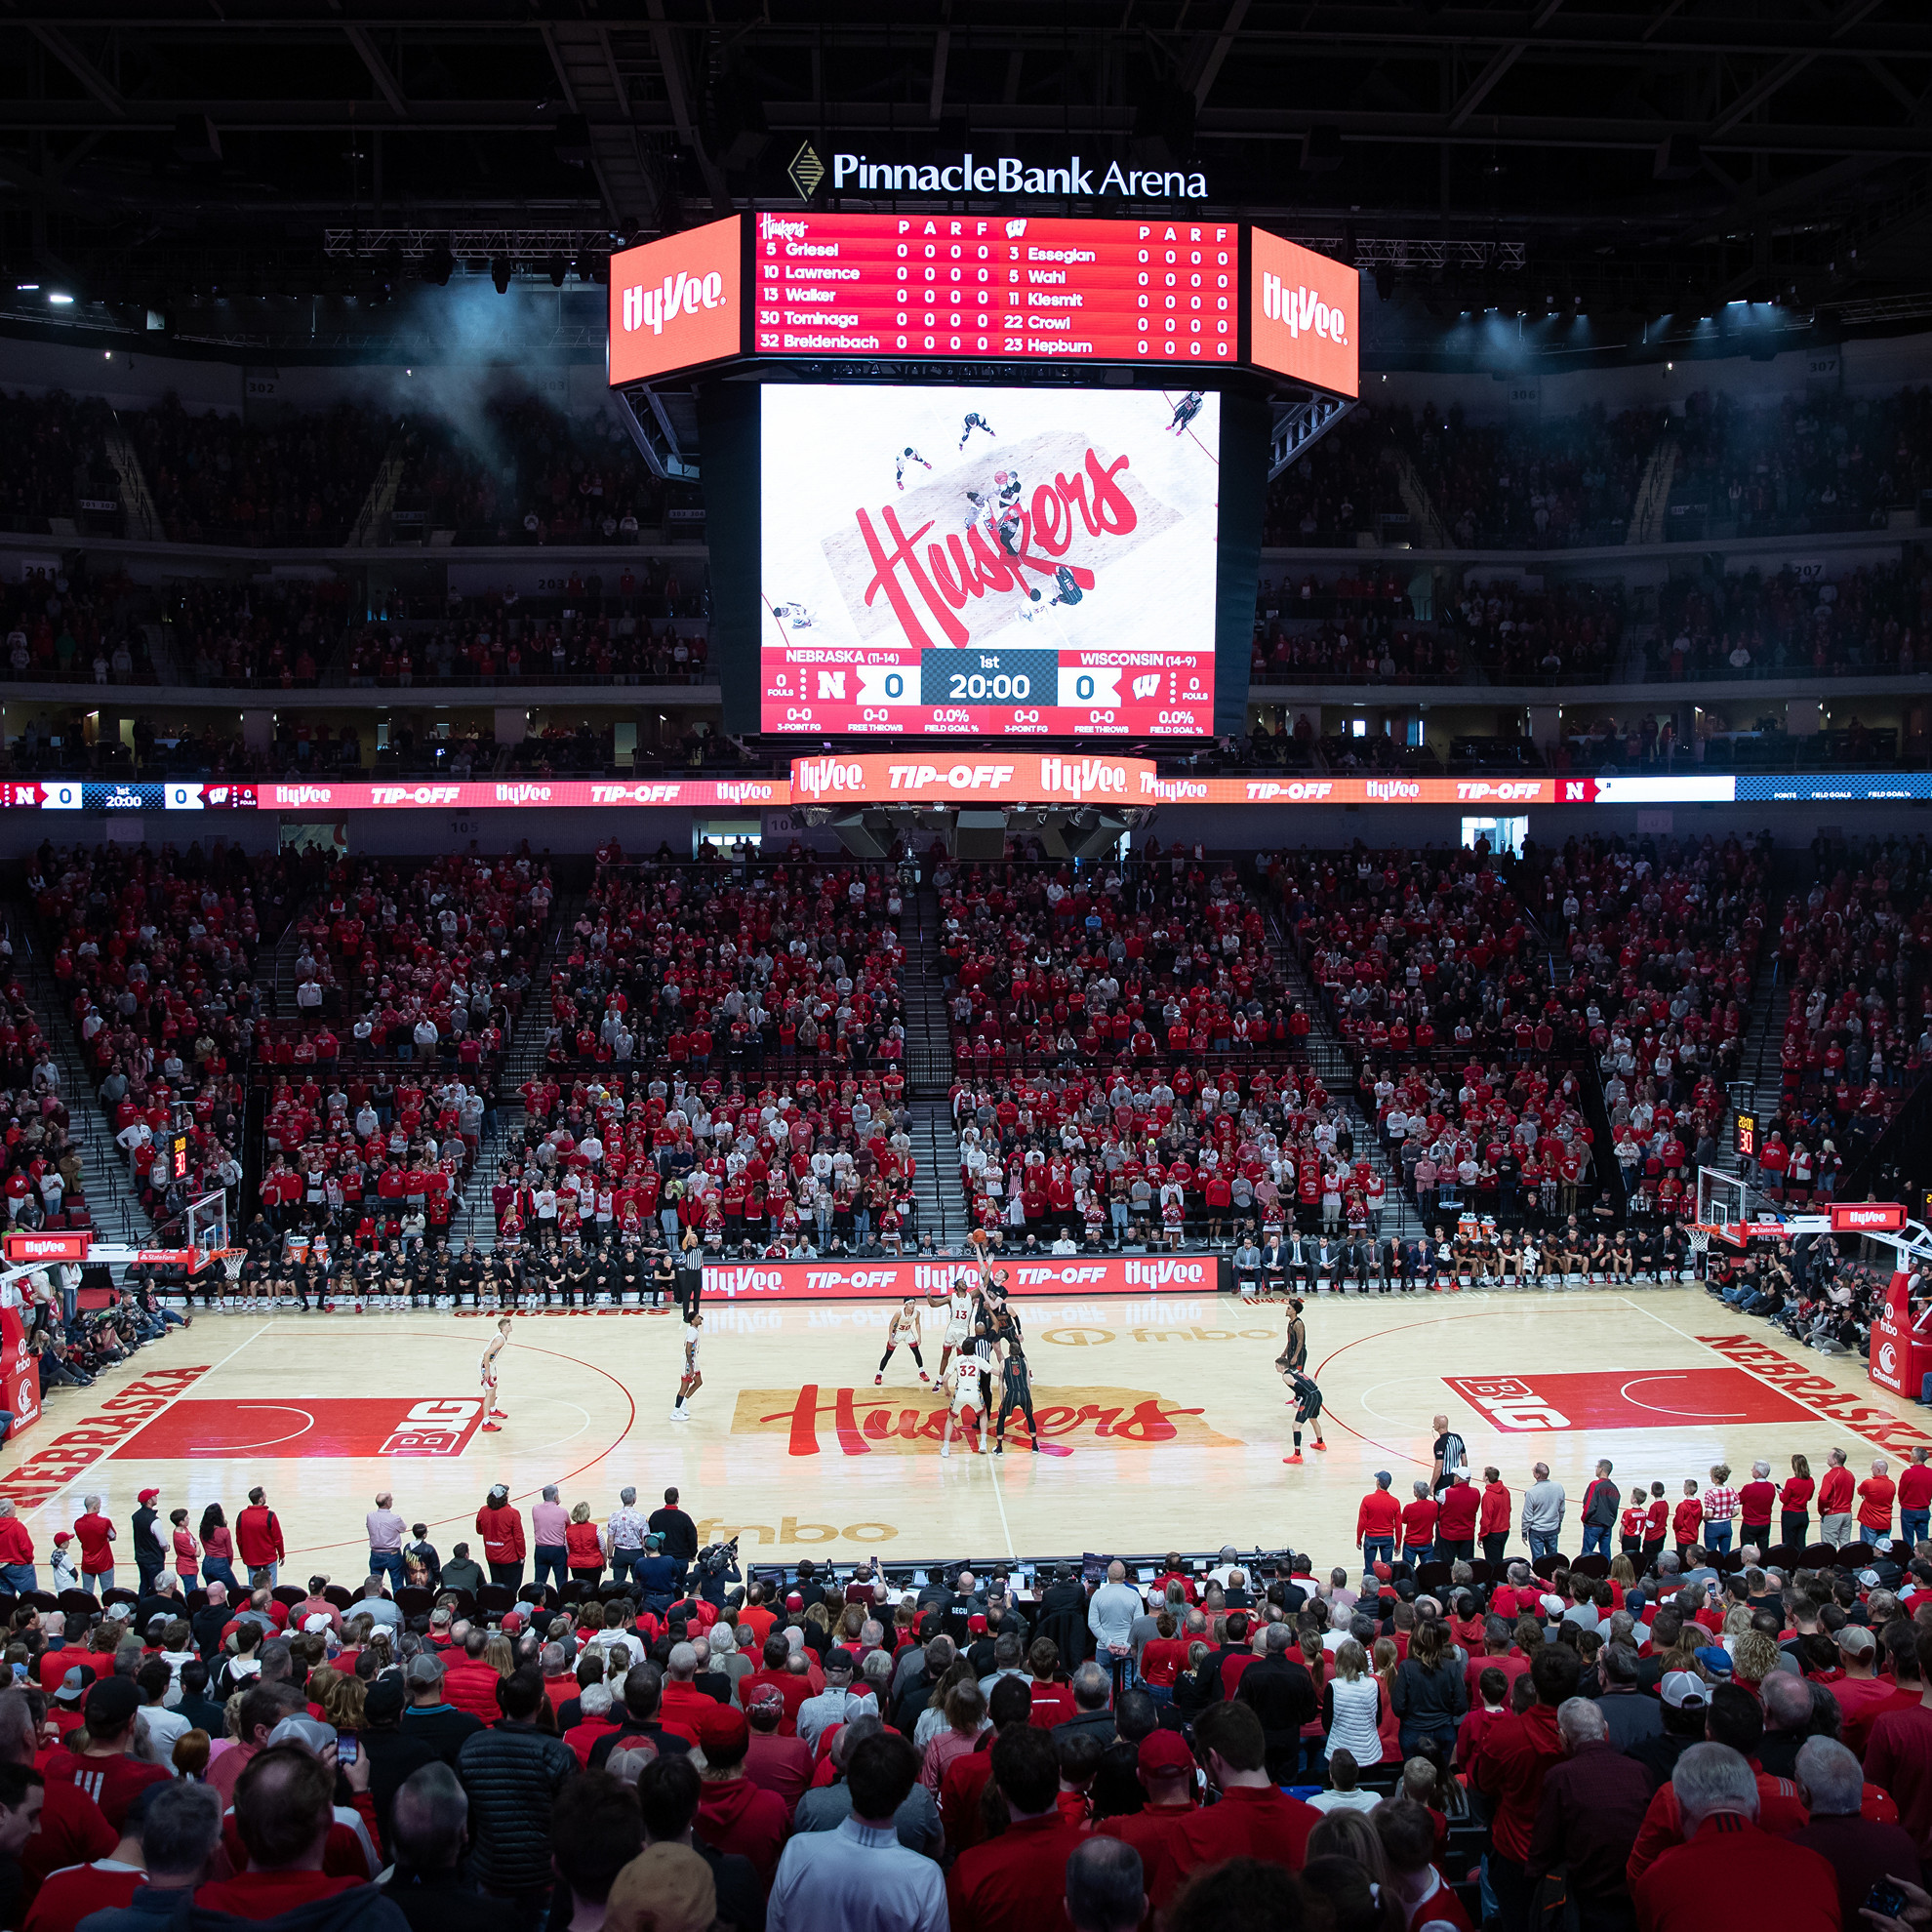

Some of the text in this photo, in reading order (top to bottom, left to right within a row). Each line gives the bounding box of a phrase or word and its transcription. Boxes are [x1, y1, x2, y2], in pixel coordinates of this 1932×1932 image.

[834, 153, 1209, 198] PinnacleBank Arena
[899, 221, 909, 234] P
[924, 221, 936, 234] A
[950, 222, 961, 235] R
[978, 222, 986, 235] F
[1140, 226, 1150, 239] P
[1164, 227, 1176, 240] A
[1191, 228, 1201, 241] R
[1217, 229, 1227, 242] F
[767, 243, 988, 259] 5 Griesel 0 0 0 0
[1010, 247, 1228, 265] 3 Essegian 0 0 0 0
[764, 265, 860, 280] 10 Lawrence
[1009, 269, 1066, 284] 5 Wahl
[764, 288, 988, 304] 13 Walker 0 0 0 0
[1009, 293, 1228, 310] 11 Klesmit 0 0 0 0
[760, 311, 858, 328] 30 Tominaga
[1004, 315, 1070, 330] 22 Crowl
[760, 335, 987, 350] 32 Breidenbach 0 0 0 0
[1004, 338, 1228, 356] 23 Hepburn 0 0 0 0
[249, 382, 274, 394] 302
[856, 448, 1137, 649] Huskers
[538, 579, 565, 590] 203
[786, 650, 900, 664] NEBRASKA (11-14)
[980, 655, 1000, 668] 1st
[1080, 653, 1196, 667] WISCONSIN (14-9)
[776, 674, 786, 687] 0
[818, 671, 845, 699] N
[885, 673, 904, 698] 0
[948, 673, 1030, 700] 20:00
[1076, 675, 1094, 700] 0
[1189, 677, 1199, 690] 0
[787, 708, 812, 721] 0-0
[864, 708, 888, 721] 0-0
[934, 709, 969, 722] 0.0%
[1014, 710, 1039, 723] 0-0
[1090, 710, 1114, 723] 0-0
[1158, 711, 1194, 724] 0.0%
[888, 764, 1015, 789] TIP-OFF
[16, 786, 35, 805] N
[60, 787, 71, 804] 0
[116, 785, 130, 796] 1st
[175, 788, 187, 805] 0
[244, 788, 252, 799] 0
[371, 786, 460, 805] TIP-OFF
[590, 785, 680, 803] TIP-OFF
[1245, 782, 1333, 799] TIP-OFF
[1456, 782, 1542, 799] TIP-OFF
[1565, 782, 1585, 800] N
[106, 795, 141, 808] 20:00
[451, 822, 479, 833] 105
[1738, 1114, 1754, 1132] 20:00
[1740, 1129, 1753, 1154] 30
[175, 1151, 186, 1178] 30
[806, 1271, 898, 1289] TIP-OFF
[1017, 1267, 1108, 1285] TIP-OFF
[955, 1309, 967, 1320] 13
[1126, 1326, 1279, 1343] fnbo
[1879, 1317, 1898, 1337] fnbo
[15, 1356, 31, 1375] fnbo
[959, 1365, 976, 1377] 32
[1872, 1366, 1901, 1389] Channel
[14, 1405, 38, 1429] Channel
[759, 1384, 1205, 1457] Huskers
[696, 1516, 899, 1545] fnbo
